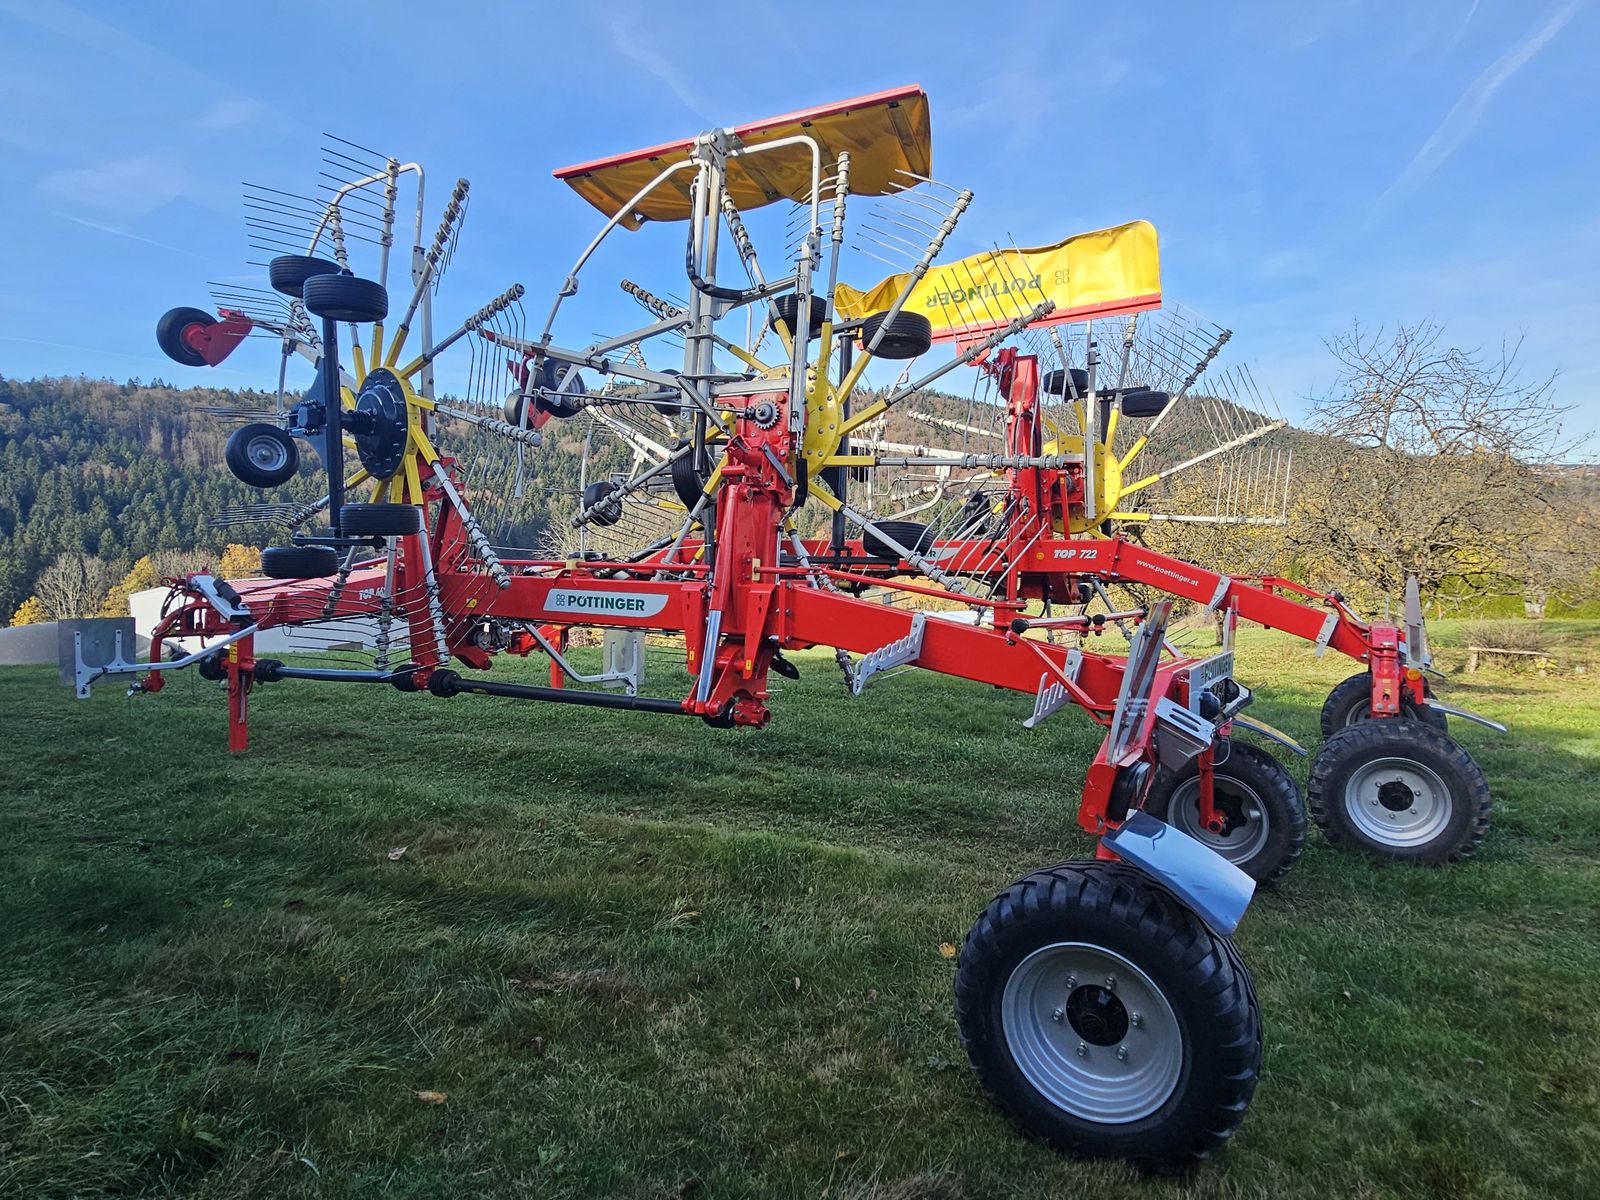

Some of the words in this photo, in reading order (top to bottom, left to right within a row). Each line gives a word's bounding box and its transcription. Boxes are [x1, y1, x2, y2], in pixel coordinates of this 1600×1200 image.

[1053, 549, 1077, 559] TOP
[1079, 549, 1098, 559] 722
[1136, 559, 1199, 587] www.poettinger.at
[375, 586, 388, 598] 66
[567, 594, 646, 612] PÖTTINGER
